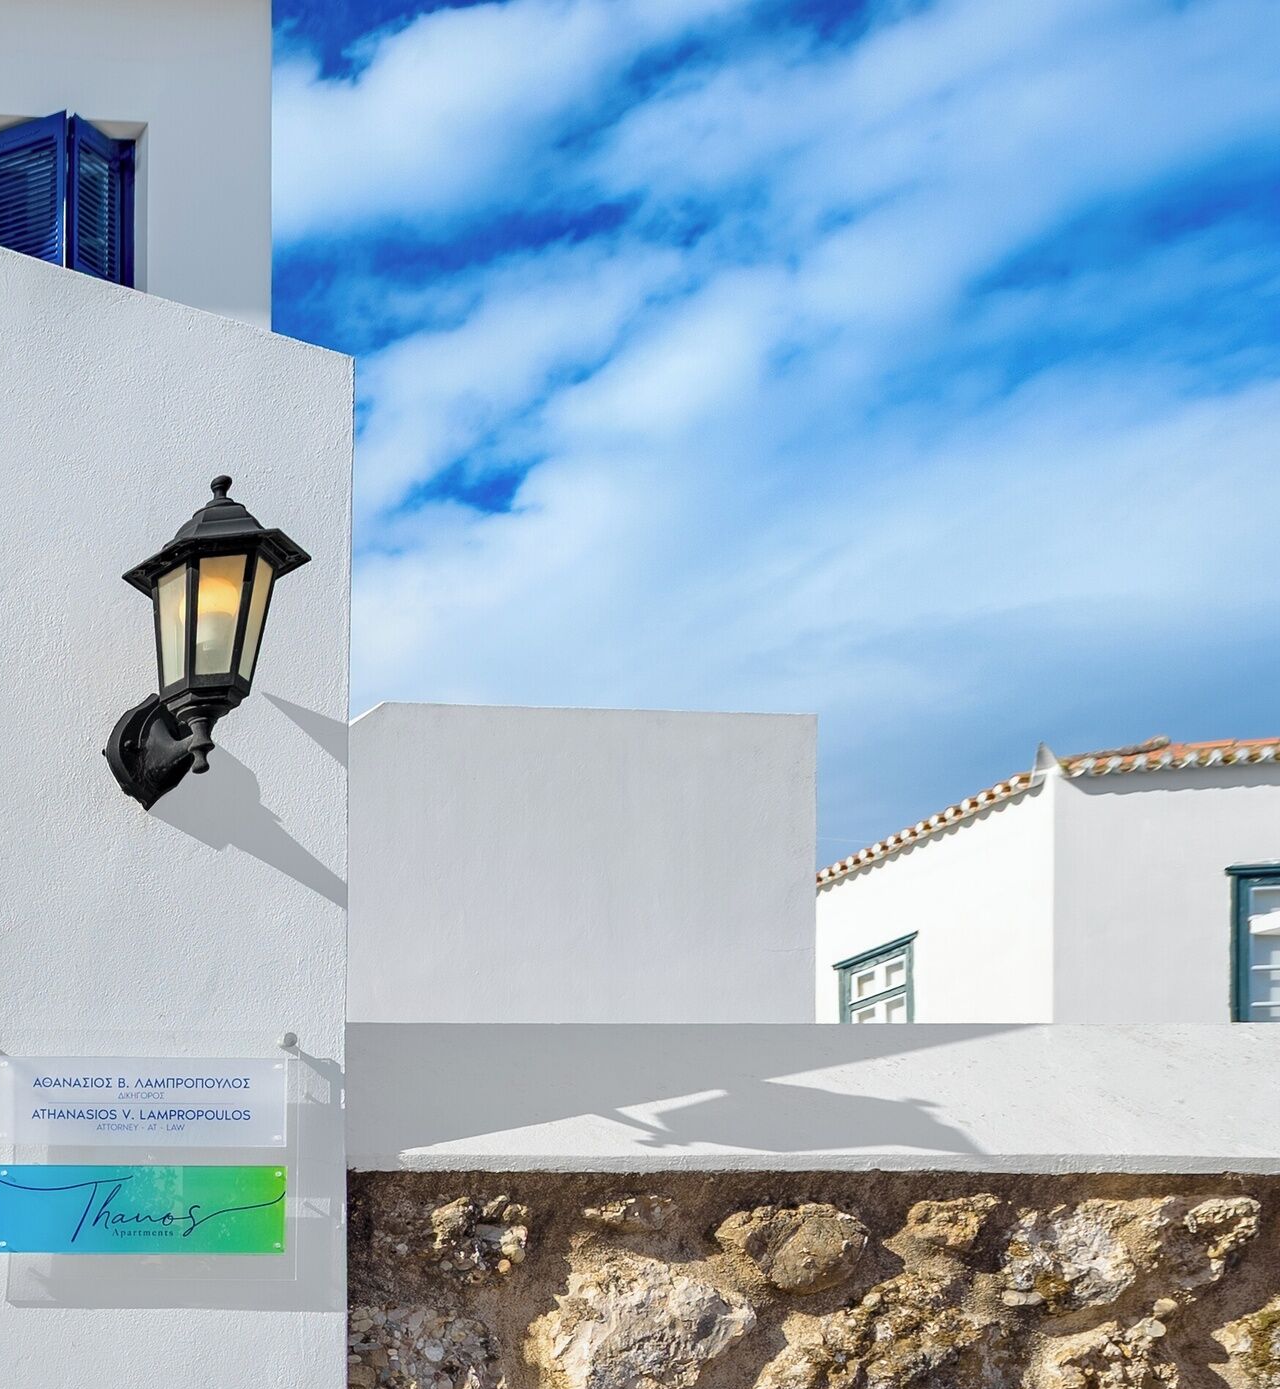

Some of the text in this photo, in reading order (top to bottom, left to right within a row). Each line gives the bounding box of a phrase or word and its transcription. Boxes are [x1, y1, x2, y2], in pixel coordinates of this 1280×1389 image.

[32, 1077, 113, 1089] ΑΘΑΝΑΣΙΟΣ
[134, 1077, 251, 1089] ΛΑΜΠΡΟΠΟΥΛΟΣ
[117, 1091, 165, 1100] ΔΙΚΗΓΟΡΟΣ
[31, 1108, 252, 1121] ATHANASIOS V. LAMPROPOULOS
[96, 1123, 139, 1132] ATTORNEY
[147, 1123, 157, 1132] AT
[166, 1123, 186, 1132] LAW
[111, 1227, 174, 1238] Apartments
